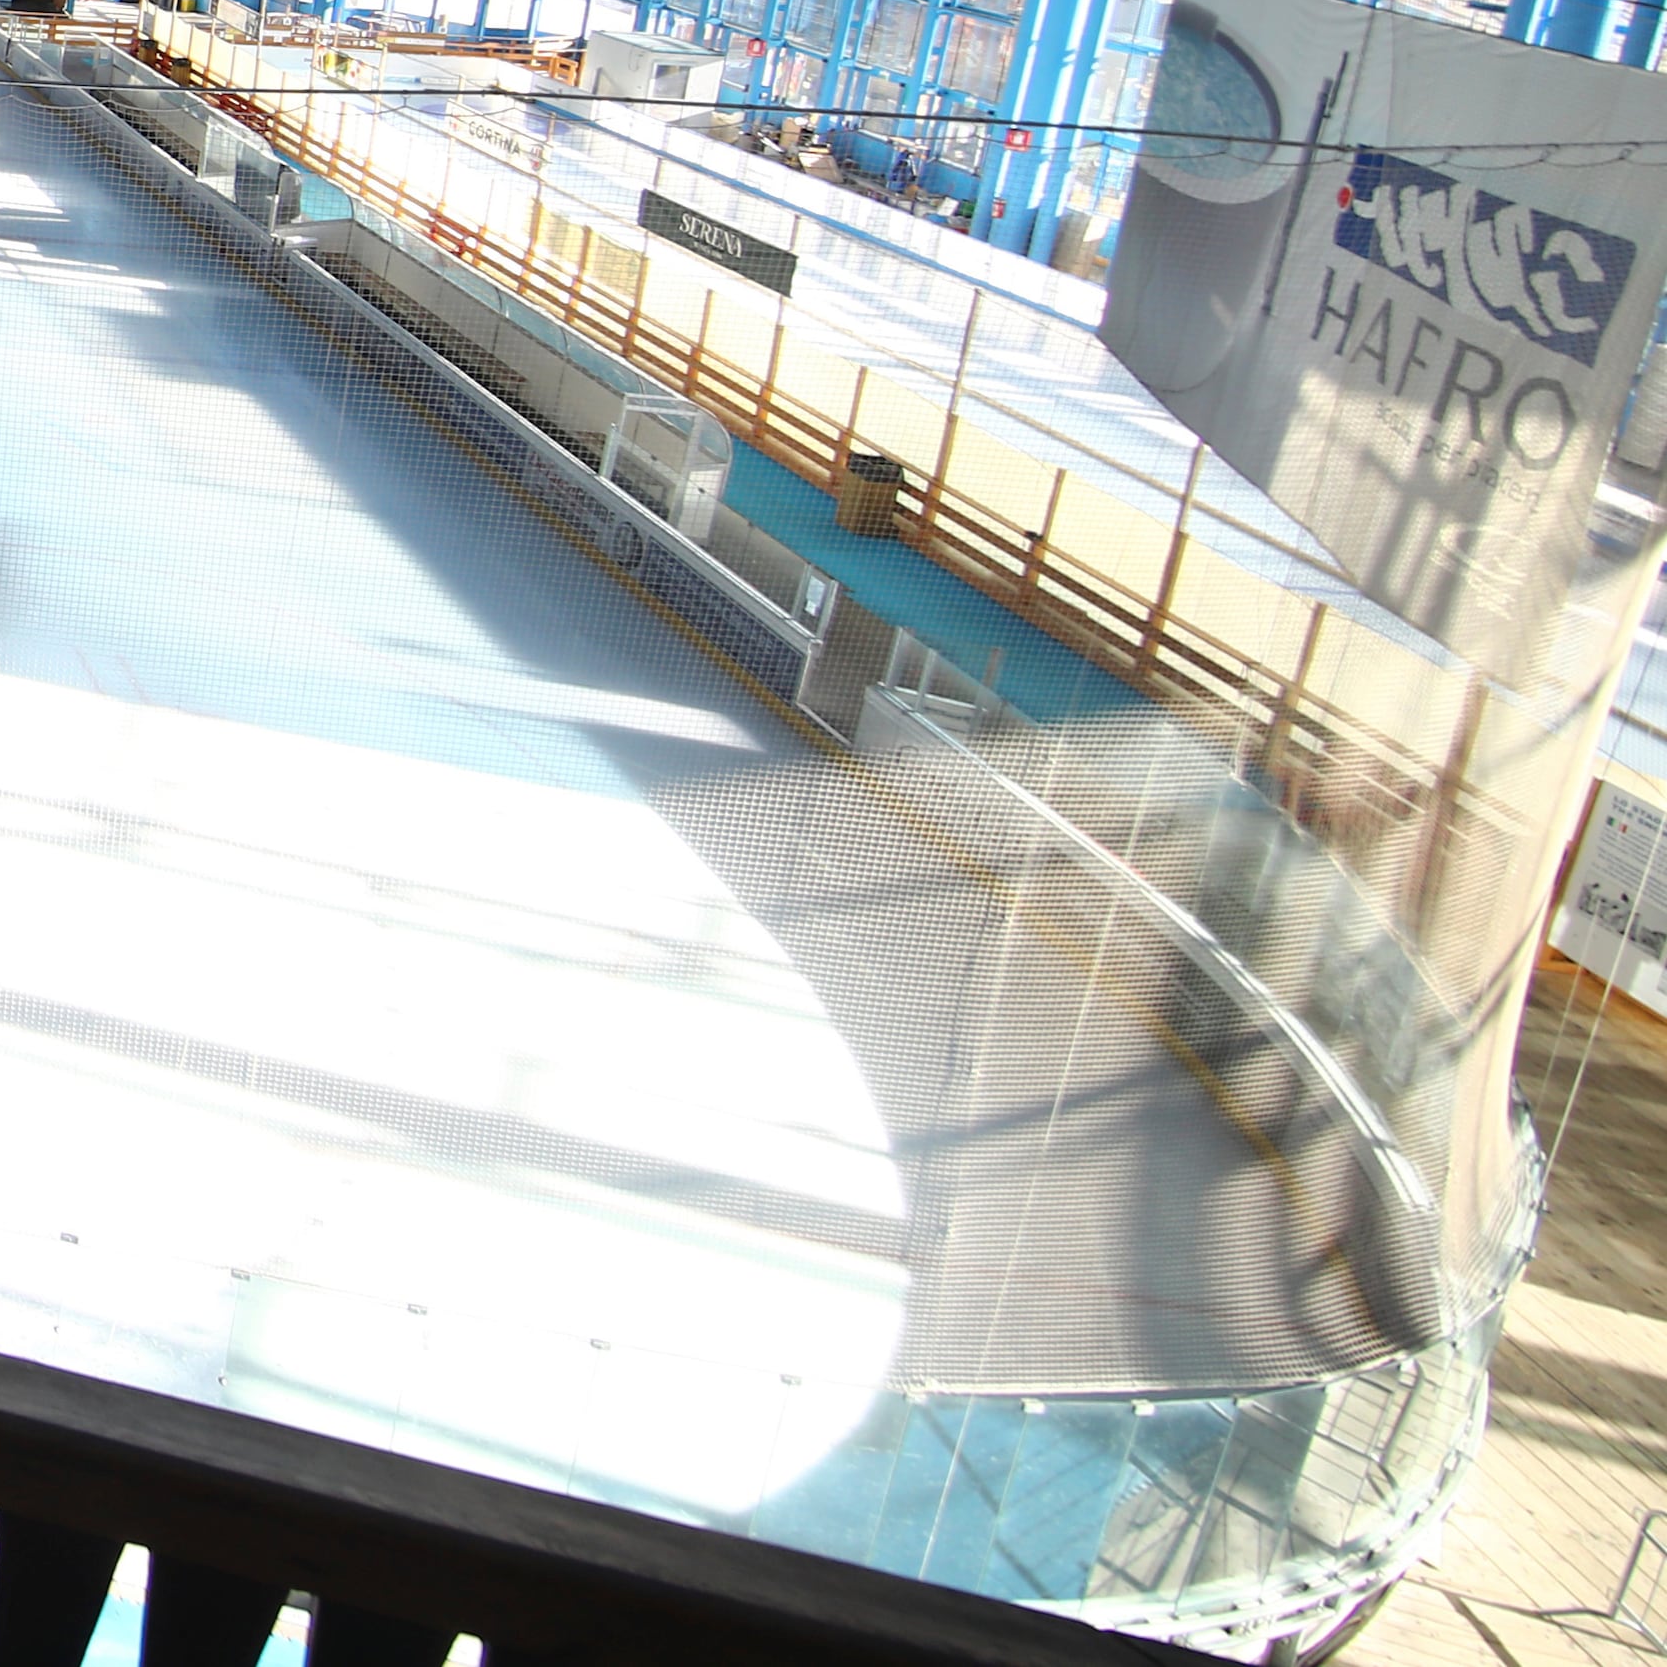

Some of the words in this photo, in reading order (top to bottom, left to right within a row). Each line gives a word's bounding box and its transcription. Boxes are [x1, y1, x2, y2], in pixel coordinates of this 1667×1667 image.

[468, 120, 521, 155] CORTINA
[679, 212, 743, 259] SERENA
[1309, 264, 1578, 472] HAFRO
